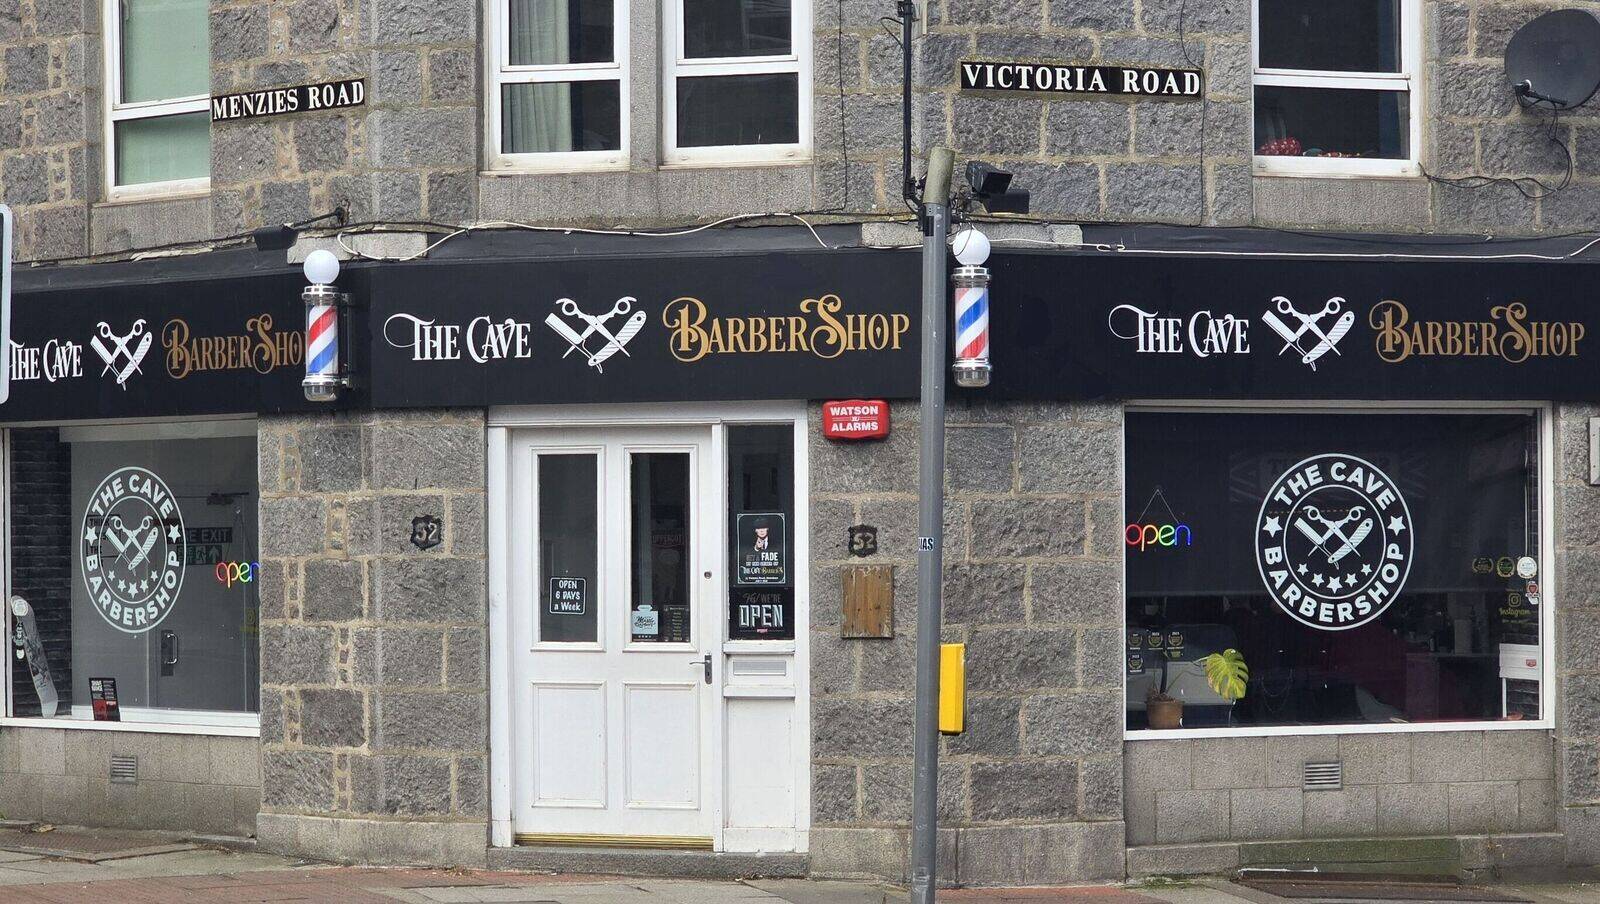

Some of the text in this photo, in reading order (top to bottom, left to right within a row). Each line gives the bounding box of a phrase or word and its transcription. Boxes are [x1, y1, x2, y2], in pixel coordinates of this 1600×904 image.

[963, 63, 1200, 95] VICTORIA ROAD
[212, 81, 364, 120] MENZIES ROAD
[383, 312, 461, 361] THE
[466, 315, 532, 364] CAVE
[1108, 304, 1183, 353] THE
[1188, 309, 1250, 358] CAVE
[42, 338, 83, 383] CAVE
[162, 313, 307, 379] BARBERSHO
[830, 406, 879, 416] WATSON
[831, 421, 879, 432] ALARMS
[91, 474, 174, 519] THE CAVE
[1274, 461, 1396, 510] THE CAVE
[201, 528, 229, 543] EXIT
[415, 521, 439, 541] 52
[1125, 523, 1191, 552] open
[761, 552, 779, 561] FADE
[86, 550, 180, 626] BARBERSHOP
[555, 590, 581, 600] 6 DAYS
[558, 579, 578, 589] OPEN
[1264, 542, 1404, 623] BARBERSHOP
[560, 601, 581, 611] Week
[738, 604, 783, 628] OPEN
